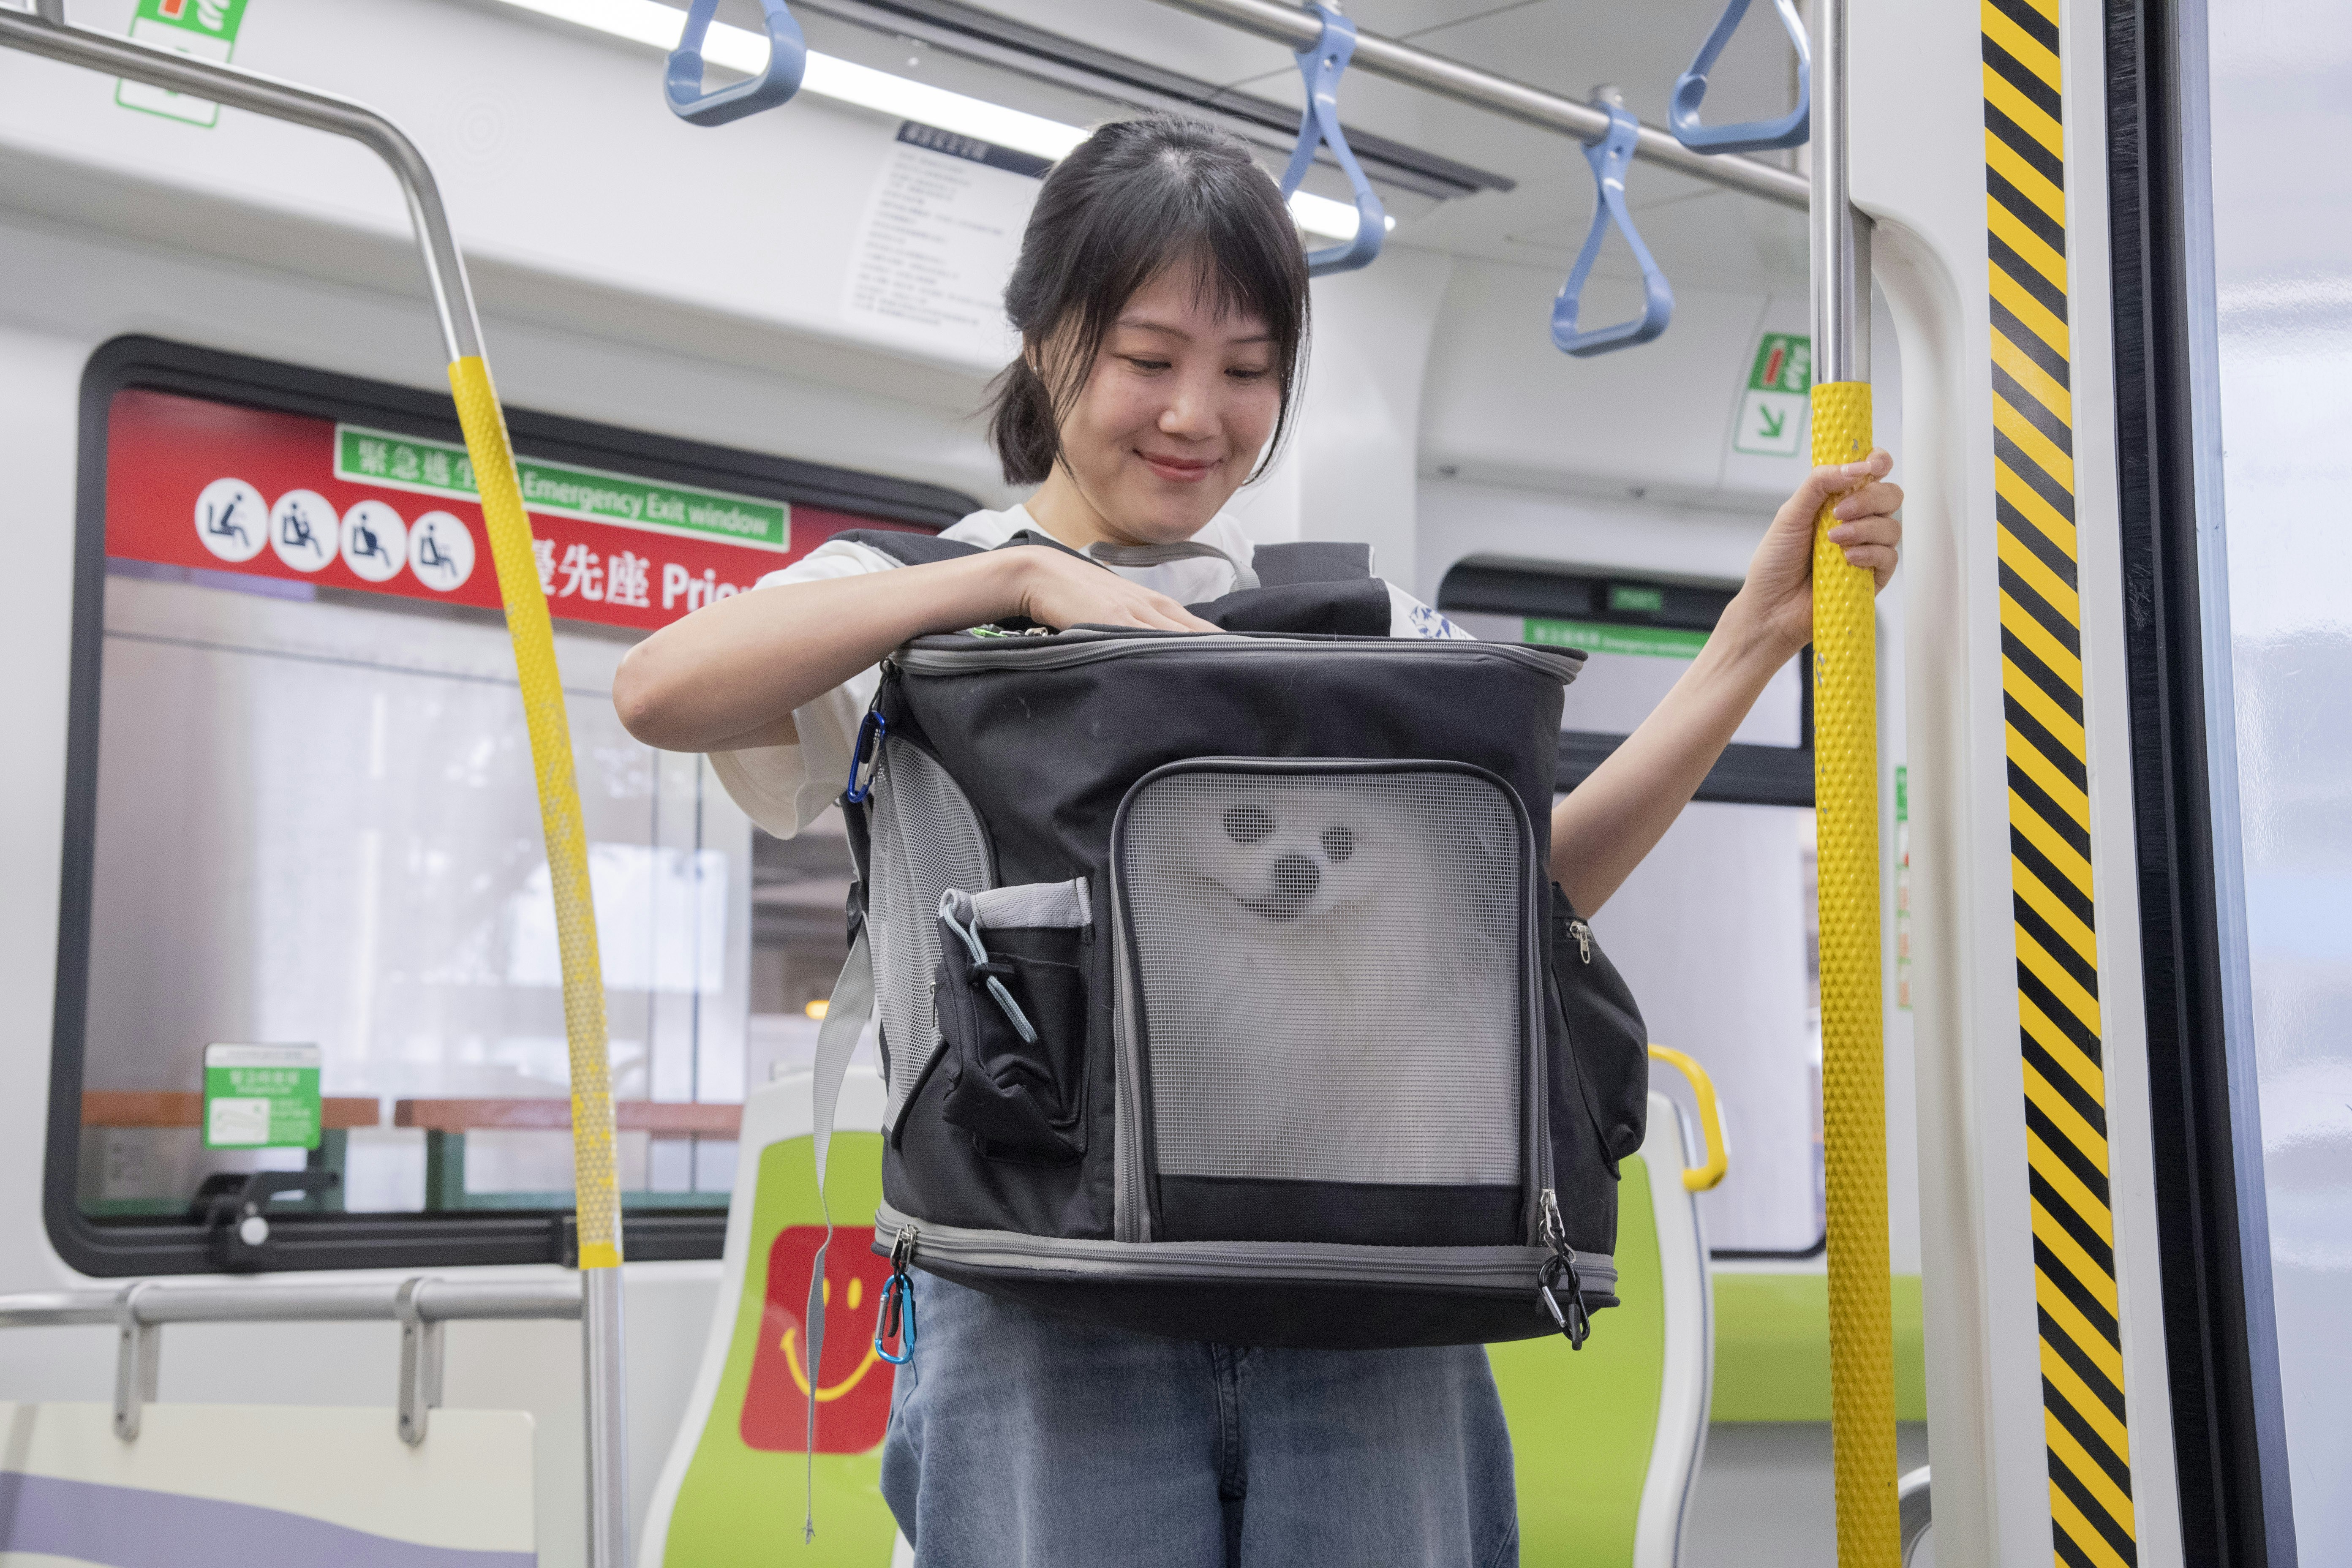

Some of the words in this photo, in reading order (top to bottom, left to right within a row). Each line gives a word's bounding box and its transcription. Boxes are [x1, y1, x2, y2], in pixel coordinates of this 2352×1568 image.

[523, 471, 644, 521] Emergency
[647, 492, 685, 523] Exit
[688, 502, 770, 536] window
